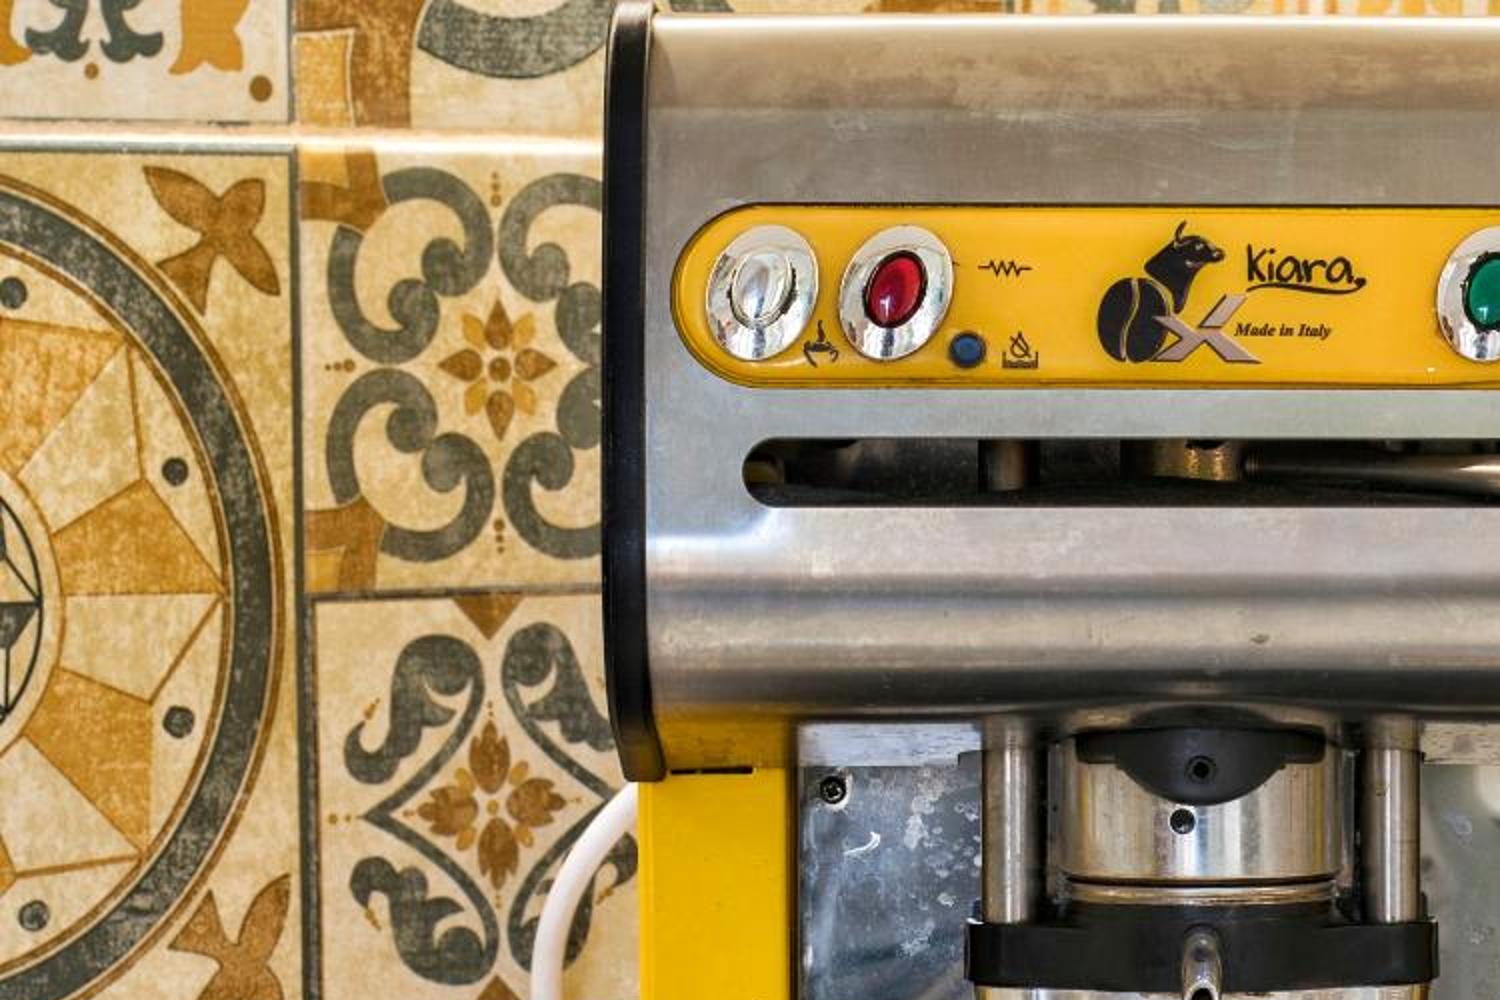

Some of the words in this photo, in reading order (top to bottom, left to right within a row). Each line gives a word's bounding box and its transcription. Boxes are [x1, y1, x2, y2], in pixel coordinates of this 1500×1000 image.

[1233, 322, 1276, 337] Made
[1278, 322, 1295, 336] in
[1297, 321, 1331, 340] Italy
